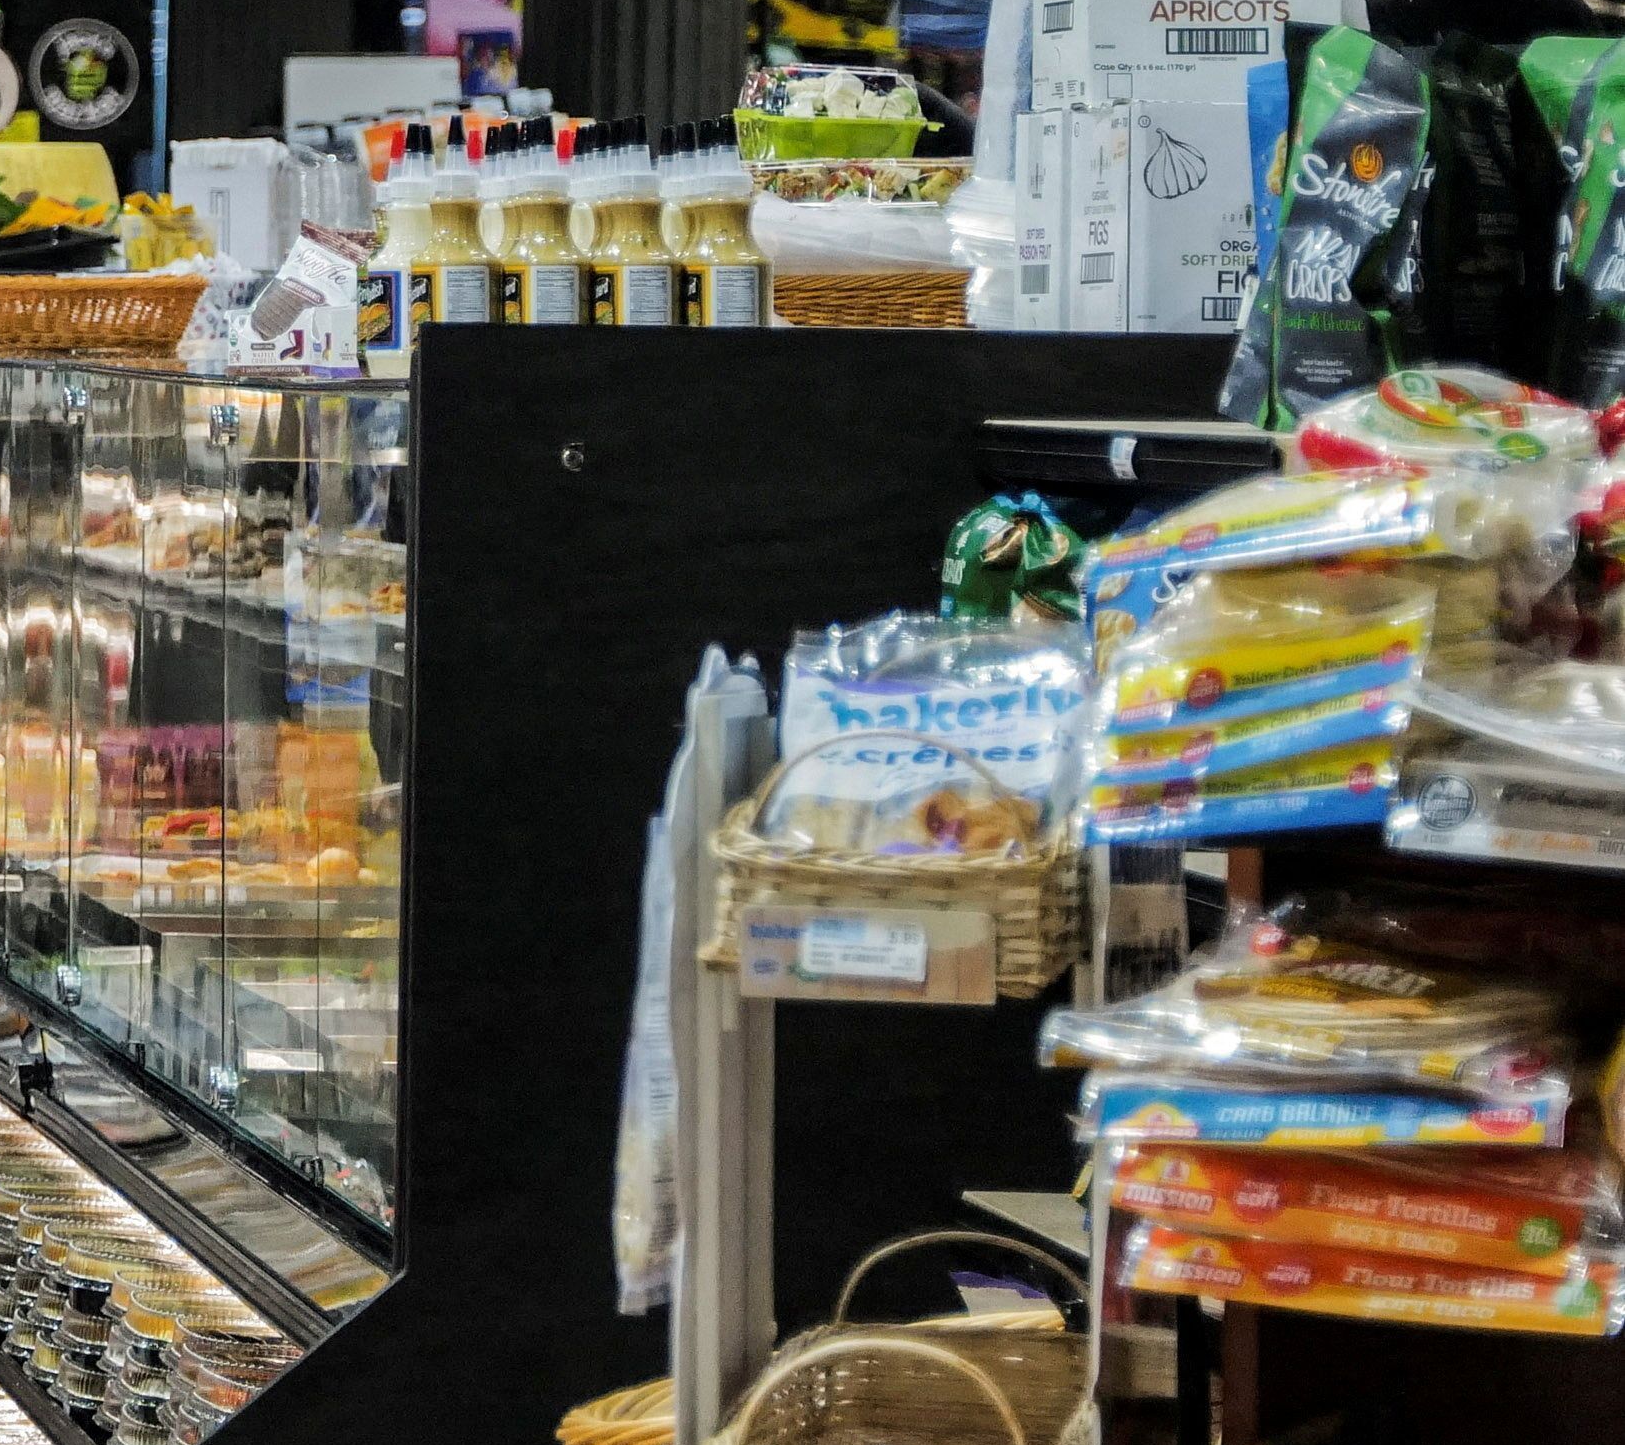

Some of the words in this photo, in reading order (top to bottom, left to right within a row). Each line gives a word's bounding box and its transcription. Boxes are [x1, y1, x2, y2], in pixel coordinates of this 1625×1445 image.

[1149, 0, 1292, 23] APRICOTS
[1093, 63, 1114, 73] Case
[1116, 63, 1136, 74] Qty:
[1167, 63, 1185, 74] (170
[1088, 219, 1110, 247] FIGS
[1220, 240, 1261, 253] ORGA
[1181, 254, 1218, 268] SOFT
[1222, 254, 1257, 267] DRIE
[1286, 258, 1353, 303] CRISPS
[1124, 1183, 1215, 1213] mission
[1308, 1183, 1379, 1216] Flour
[1387, 1194, 1500, 1233] Tortillas
[1342, 1266, 1417, 1292] Flour
[1424, 1271, 1535, 1301] Tortillas
